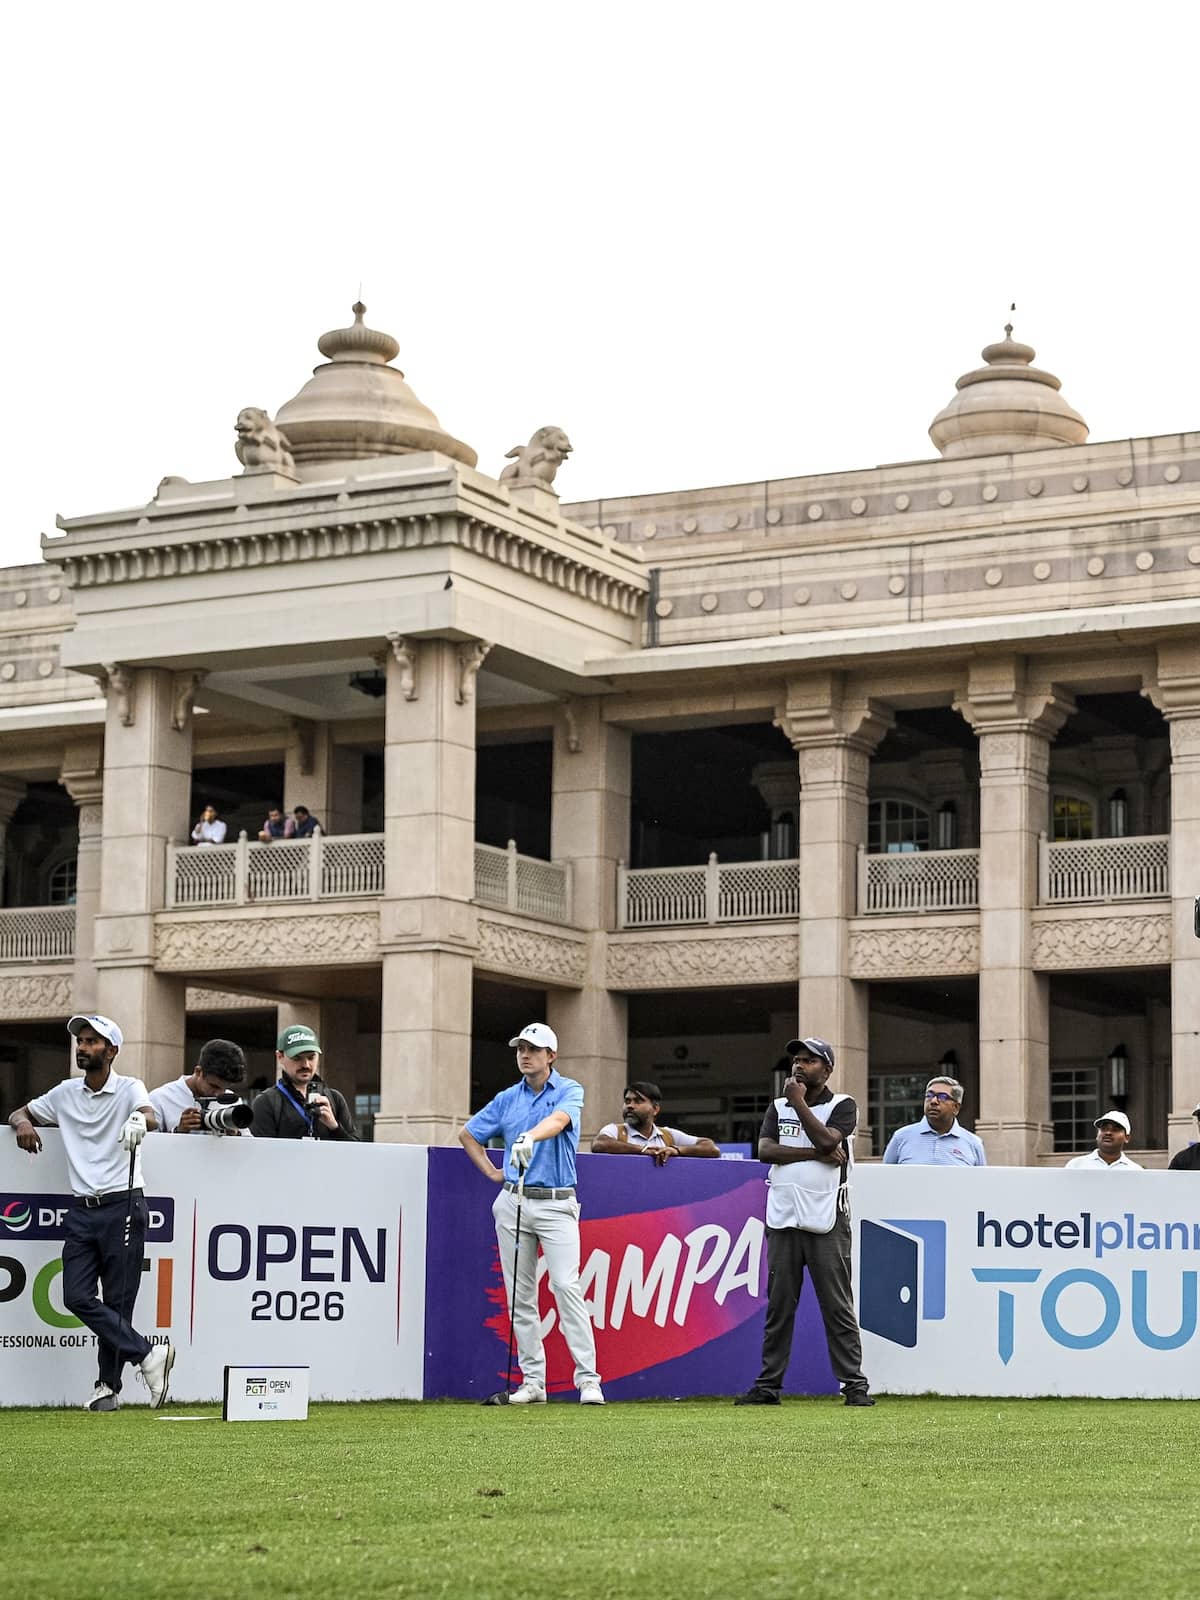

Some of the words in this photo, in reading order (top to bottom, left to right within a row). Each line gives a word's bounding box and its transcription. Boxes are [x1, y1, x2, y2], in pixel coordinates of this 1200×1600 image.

[208, 1224, 387, 1283] OPEN
[251, 1291, 344, 1321] 2026
[60, 1336, 87, 1347] GOLF
[246, 1385, 266, 1393] PGTI
